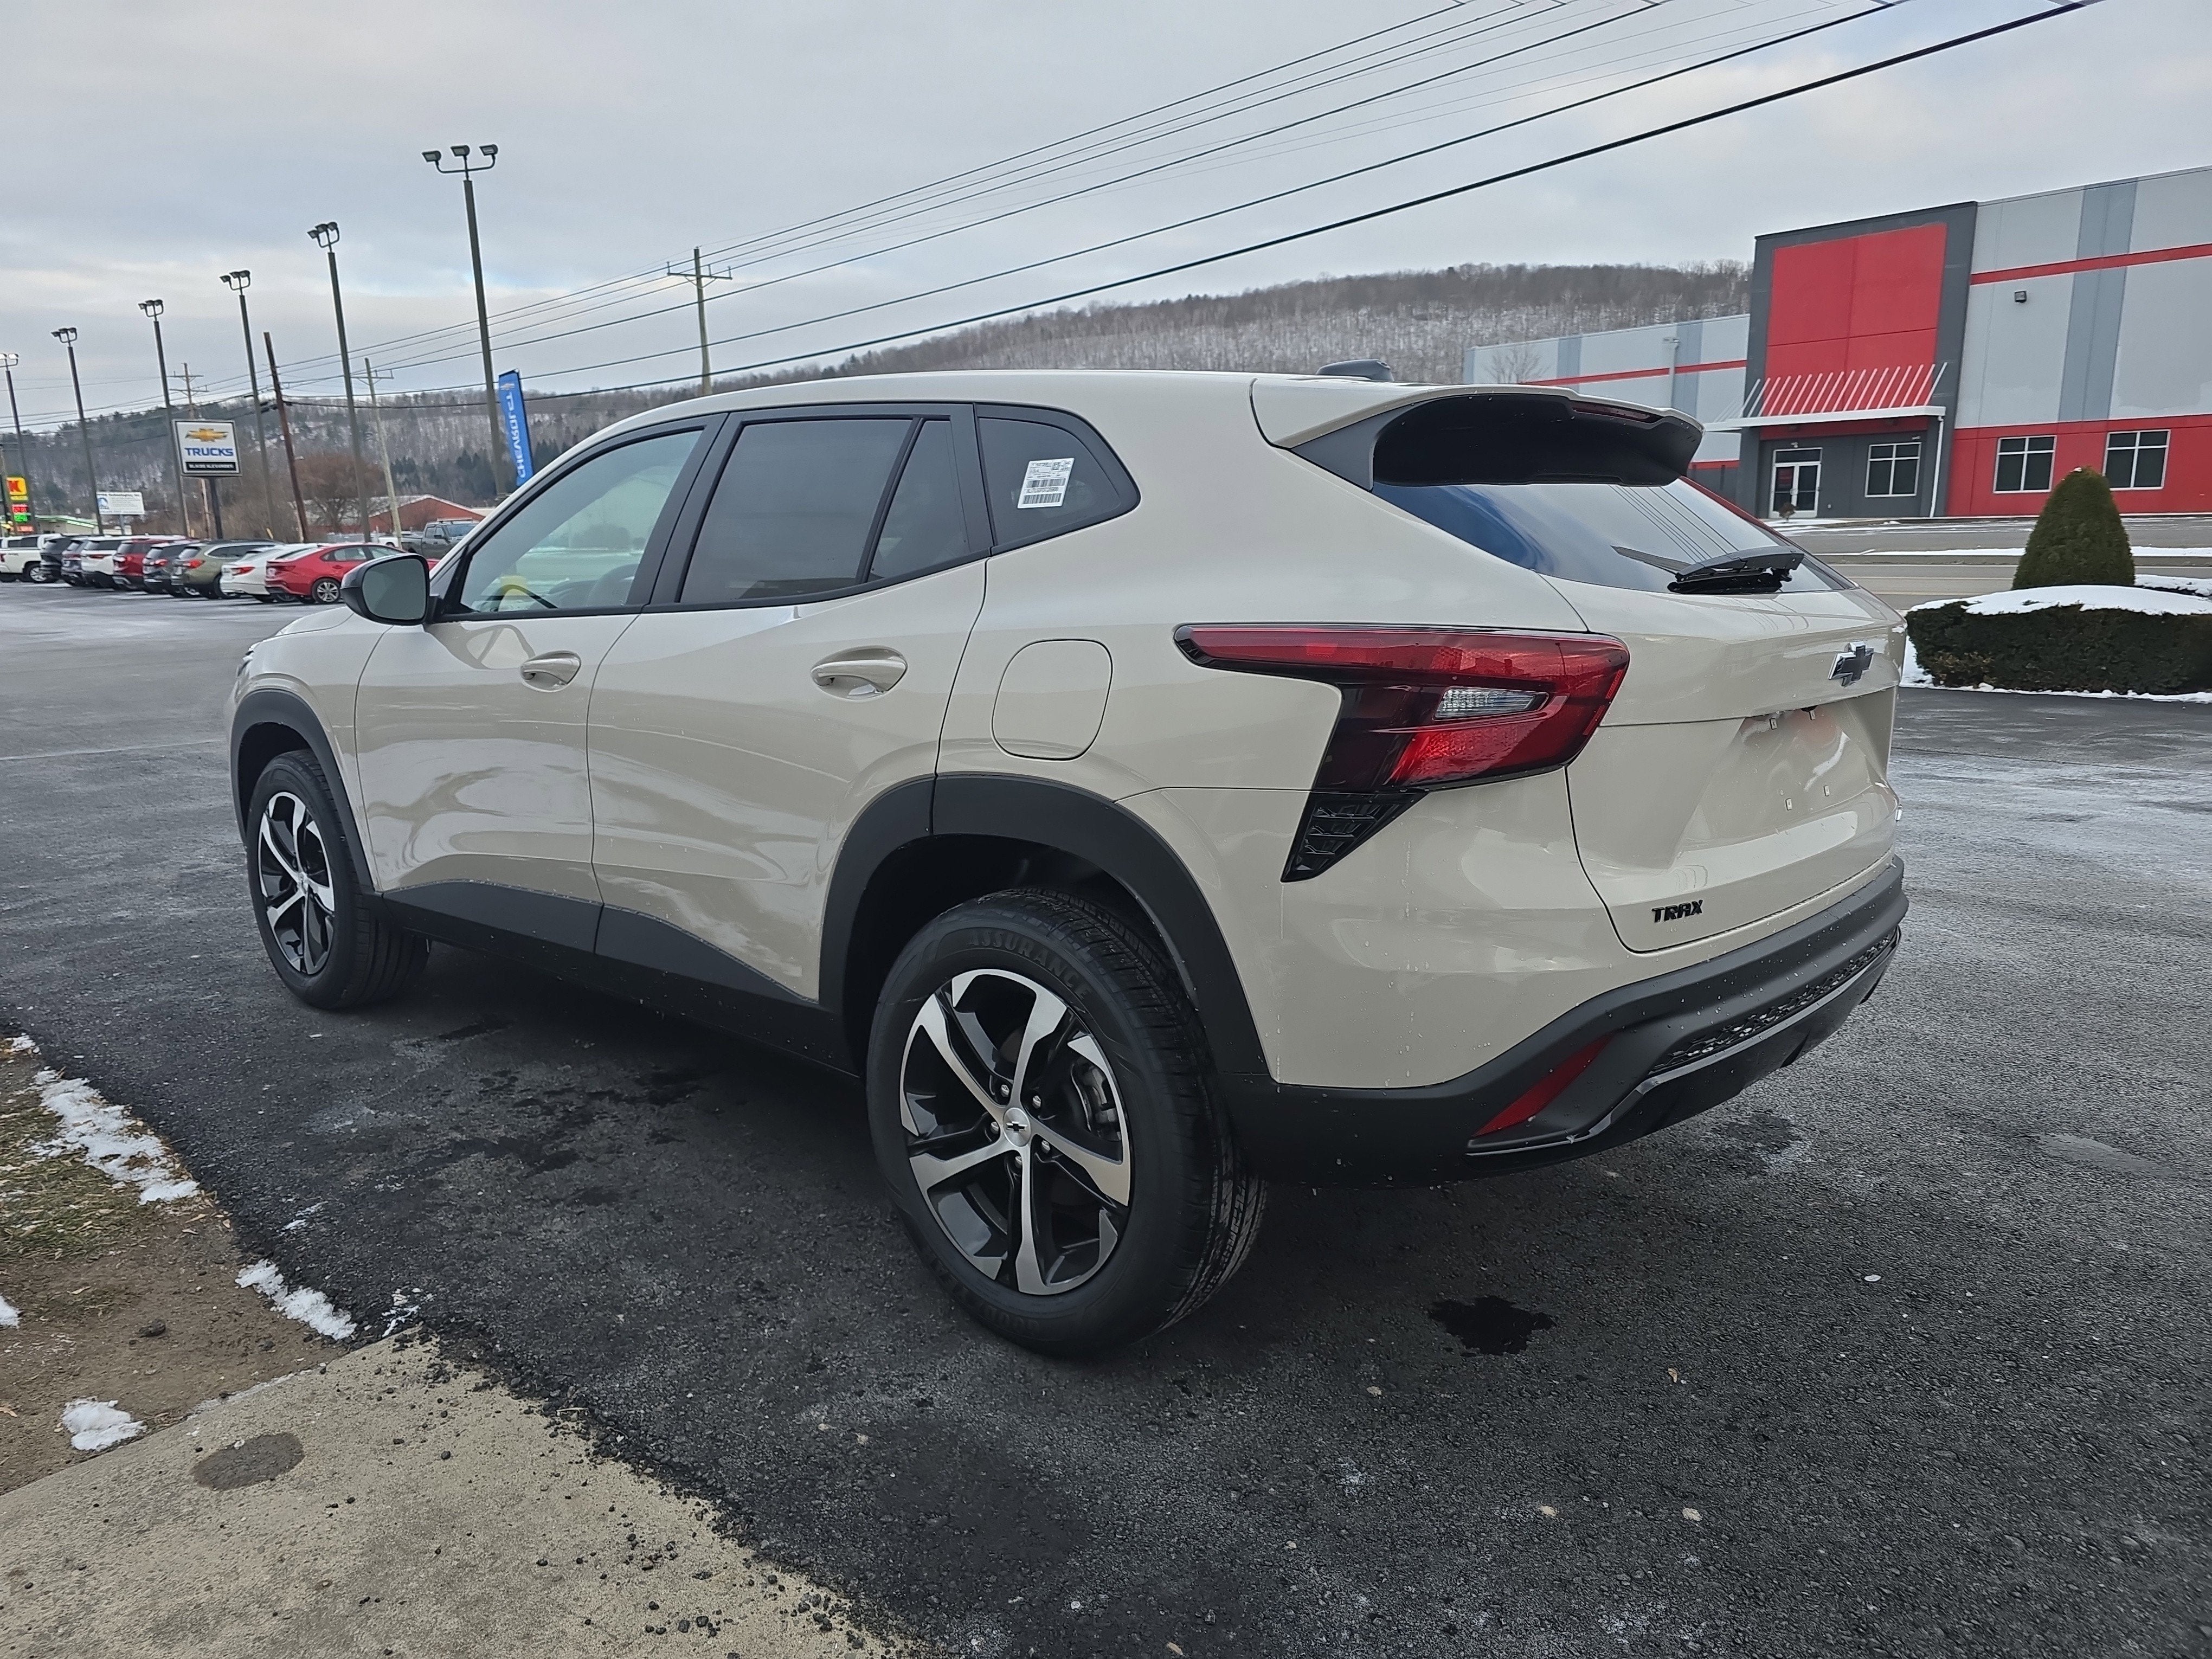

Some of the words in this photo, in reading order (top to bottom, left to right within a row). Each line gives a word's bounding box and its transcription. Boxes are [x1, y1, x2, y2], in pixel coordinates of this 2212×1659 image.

[184, 447, 234, 456] TRUCKS
[506, 392, 525, 478] CHEVROLET
[1651, 899, 1703, 923] TRAX
[968, 930, 1091, 1000] ASSURANCE
